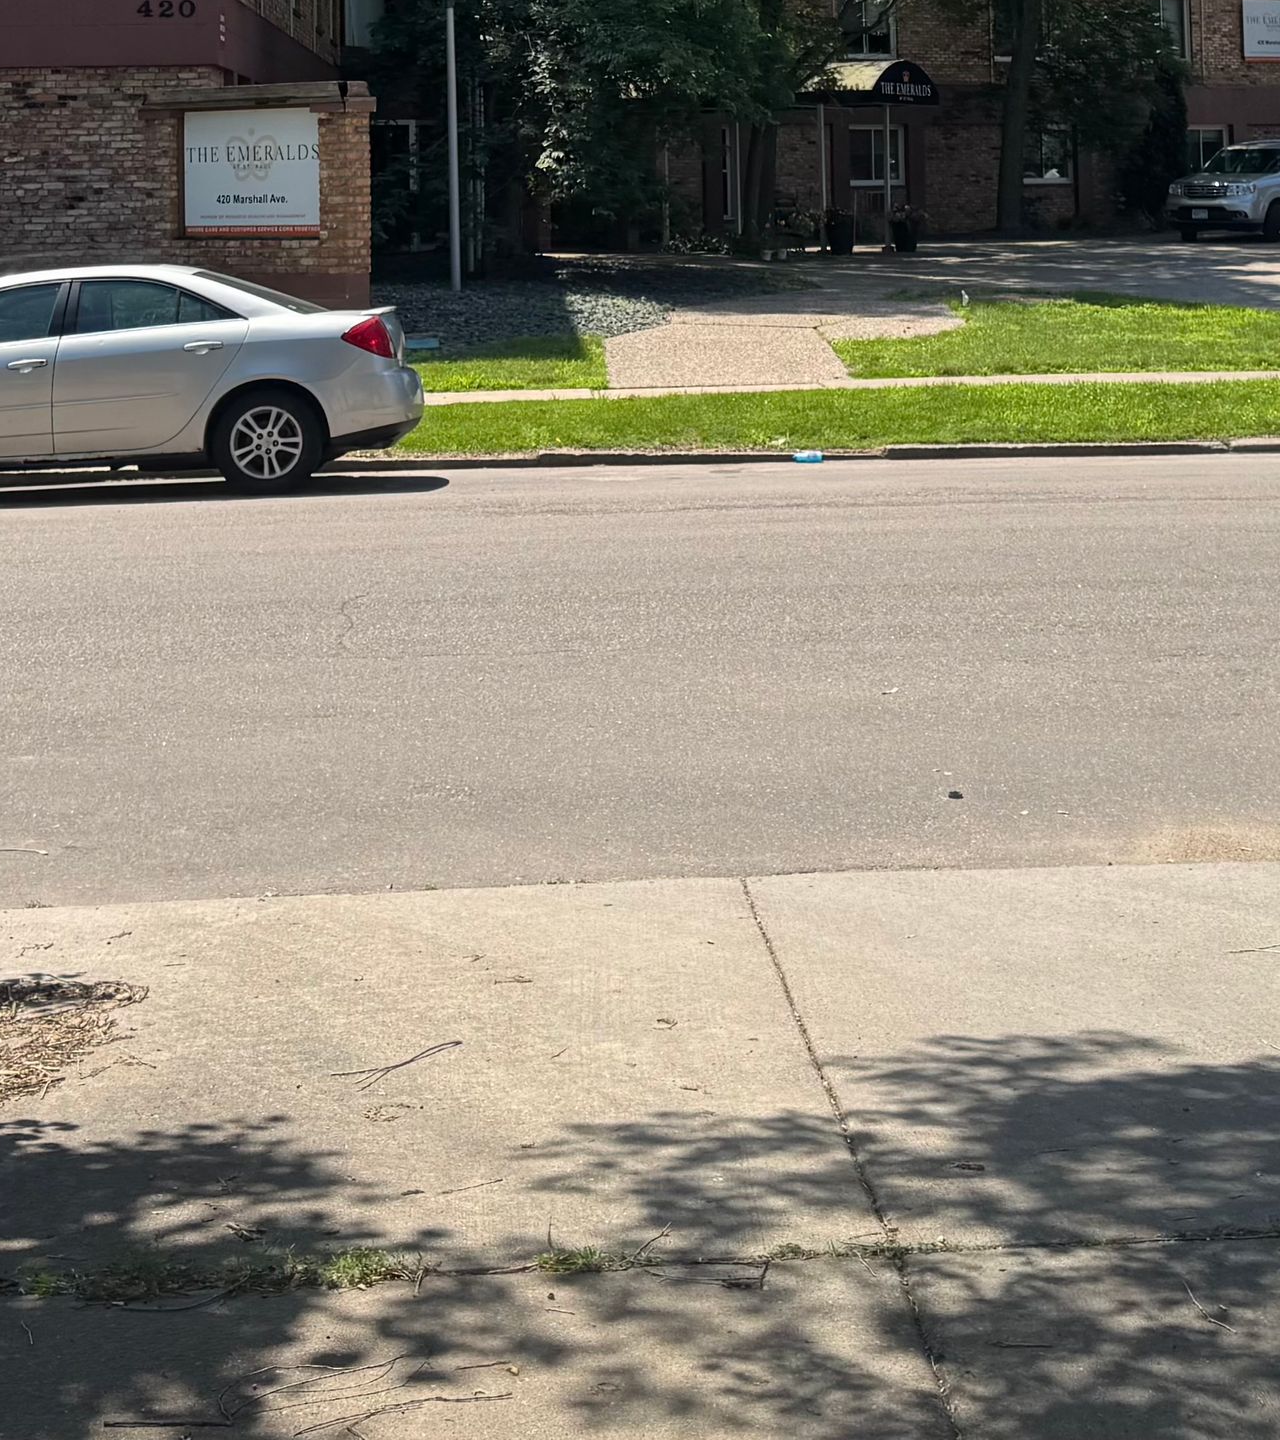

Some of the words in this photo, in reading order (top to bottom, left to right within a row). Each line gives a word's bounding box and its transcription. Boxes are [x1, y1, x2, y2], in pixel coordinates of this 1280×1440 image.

[136, 0, 196, 18] 420
[881, 82, 895, 95] THE
[896, 83, 932, 97] EMERALDS
[186, 146, 219, 163] THE
[227, 144, 320, 162] EMERALDS
[216, 194, 231, 205] 420
[233, 194, 268, 205] Marshall
[269, 193, 288, 204] Ave.
